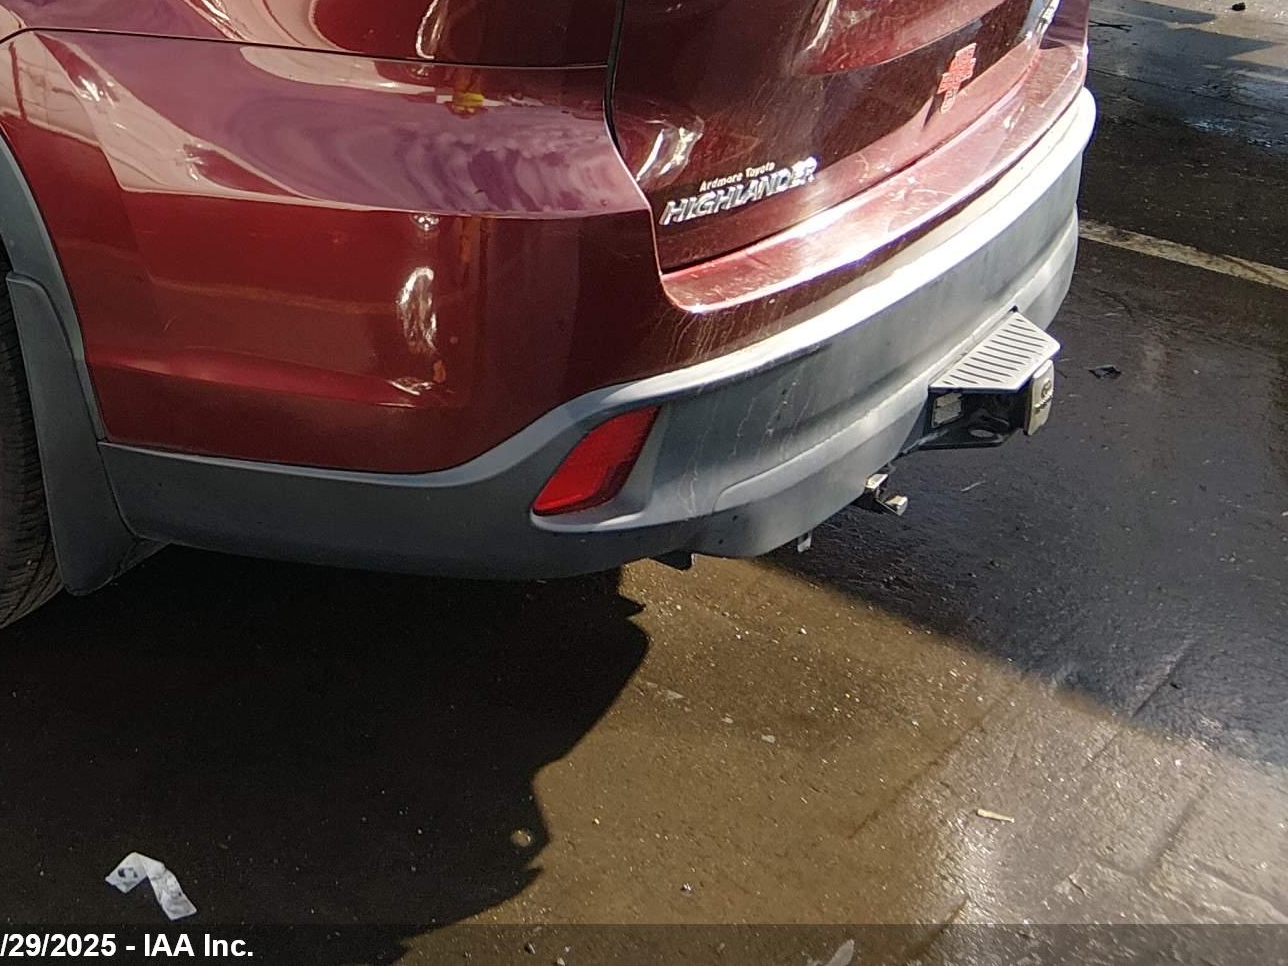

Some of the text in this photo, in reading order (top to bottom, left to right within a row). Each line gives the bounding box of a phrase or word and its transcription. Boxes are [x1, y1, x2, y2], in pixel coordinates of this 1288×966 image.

[658, 156, 819, 225] HIGHLANDER
[699, 161, 776, 193] Ardmore Toyota
